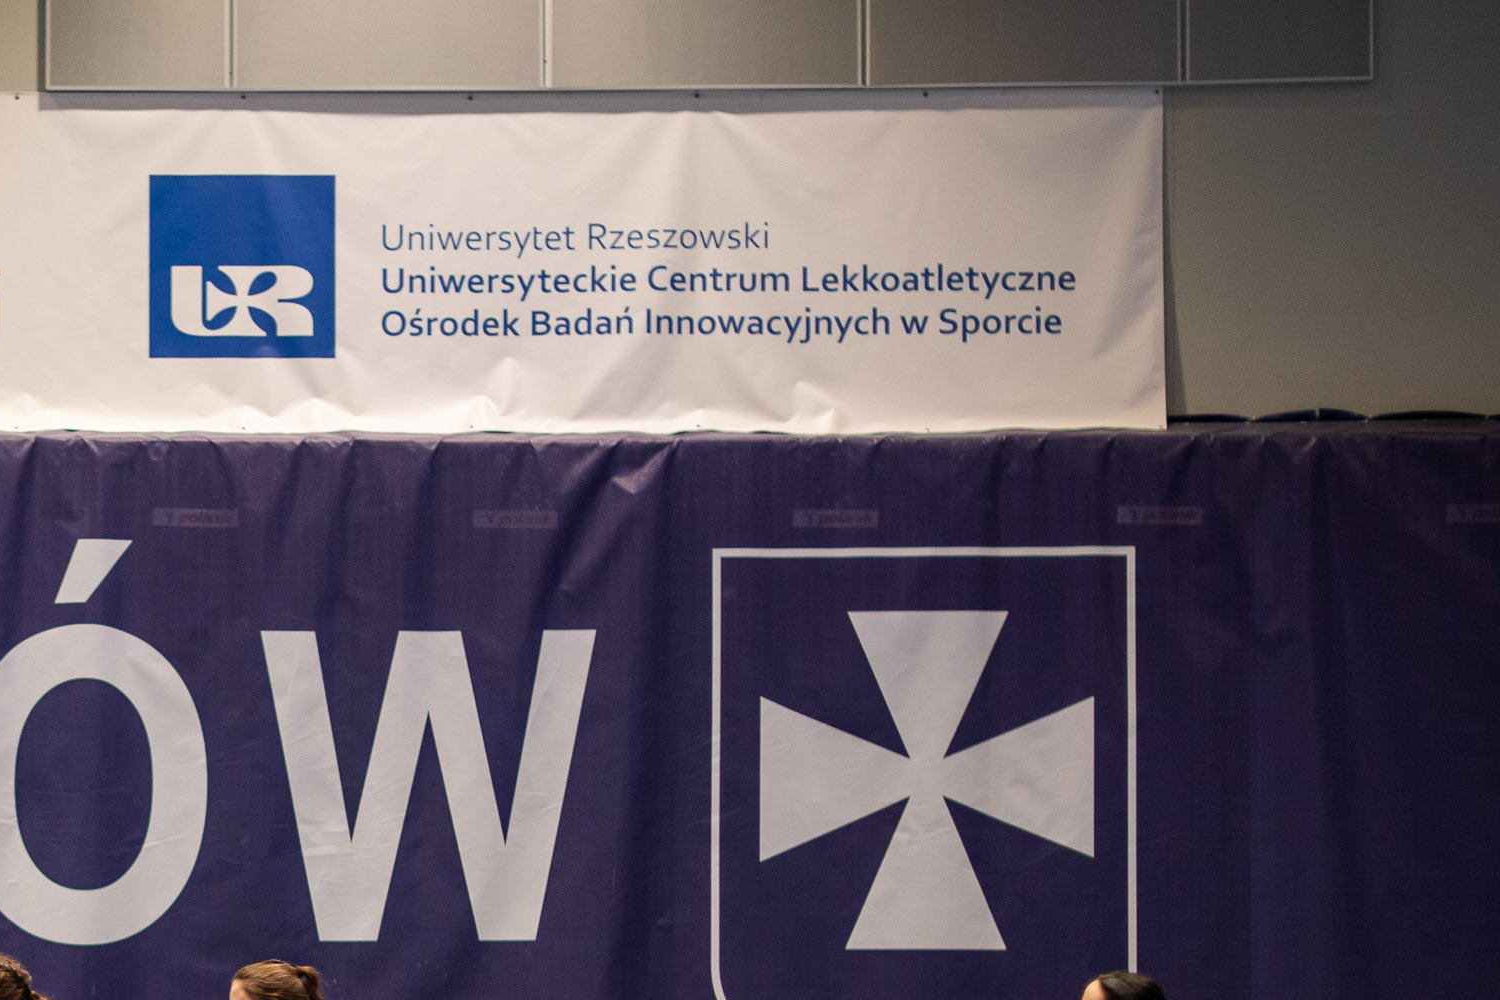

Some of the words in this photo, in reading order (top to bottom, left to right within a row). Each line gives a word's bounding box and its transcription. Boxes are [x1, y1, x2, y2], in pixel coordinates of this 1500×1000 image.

[382, 223, 576, 258] Uniwersytet
[588, 222, 769, 250] Rzeszowski
[381, 265, 637, 300] Uniwersyteckie
[647, 265, 790, 293] Centrum
[802, 263, 1077, 301] Lekkoatletyczne
[380, 307, 520, 337] Ośrodek
[531, 306, 634, 337] Badań
[645, 306, 890, 345] Innowacyjnych
[900, 315, 929, 335] w
[939, 306, 1064, 344] Sporcie
